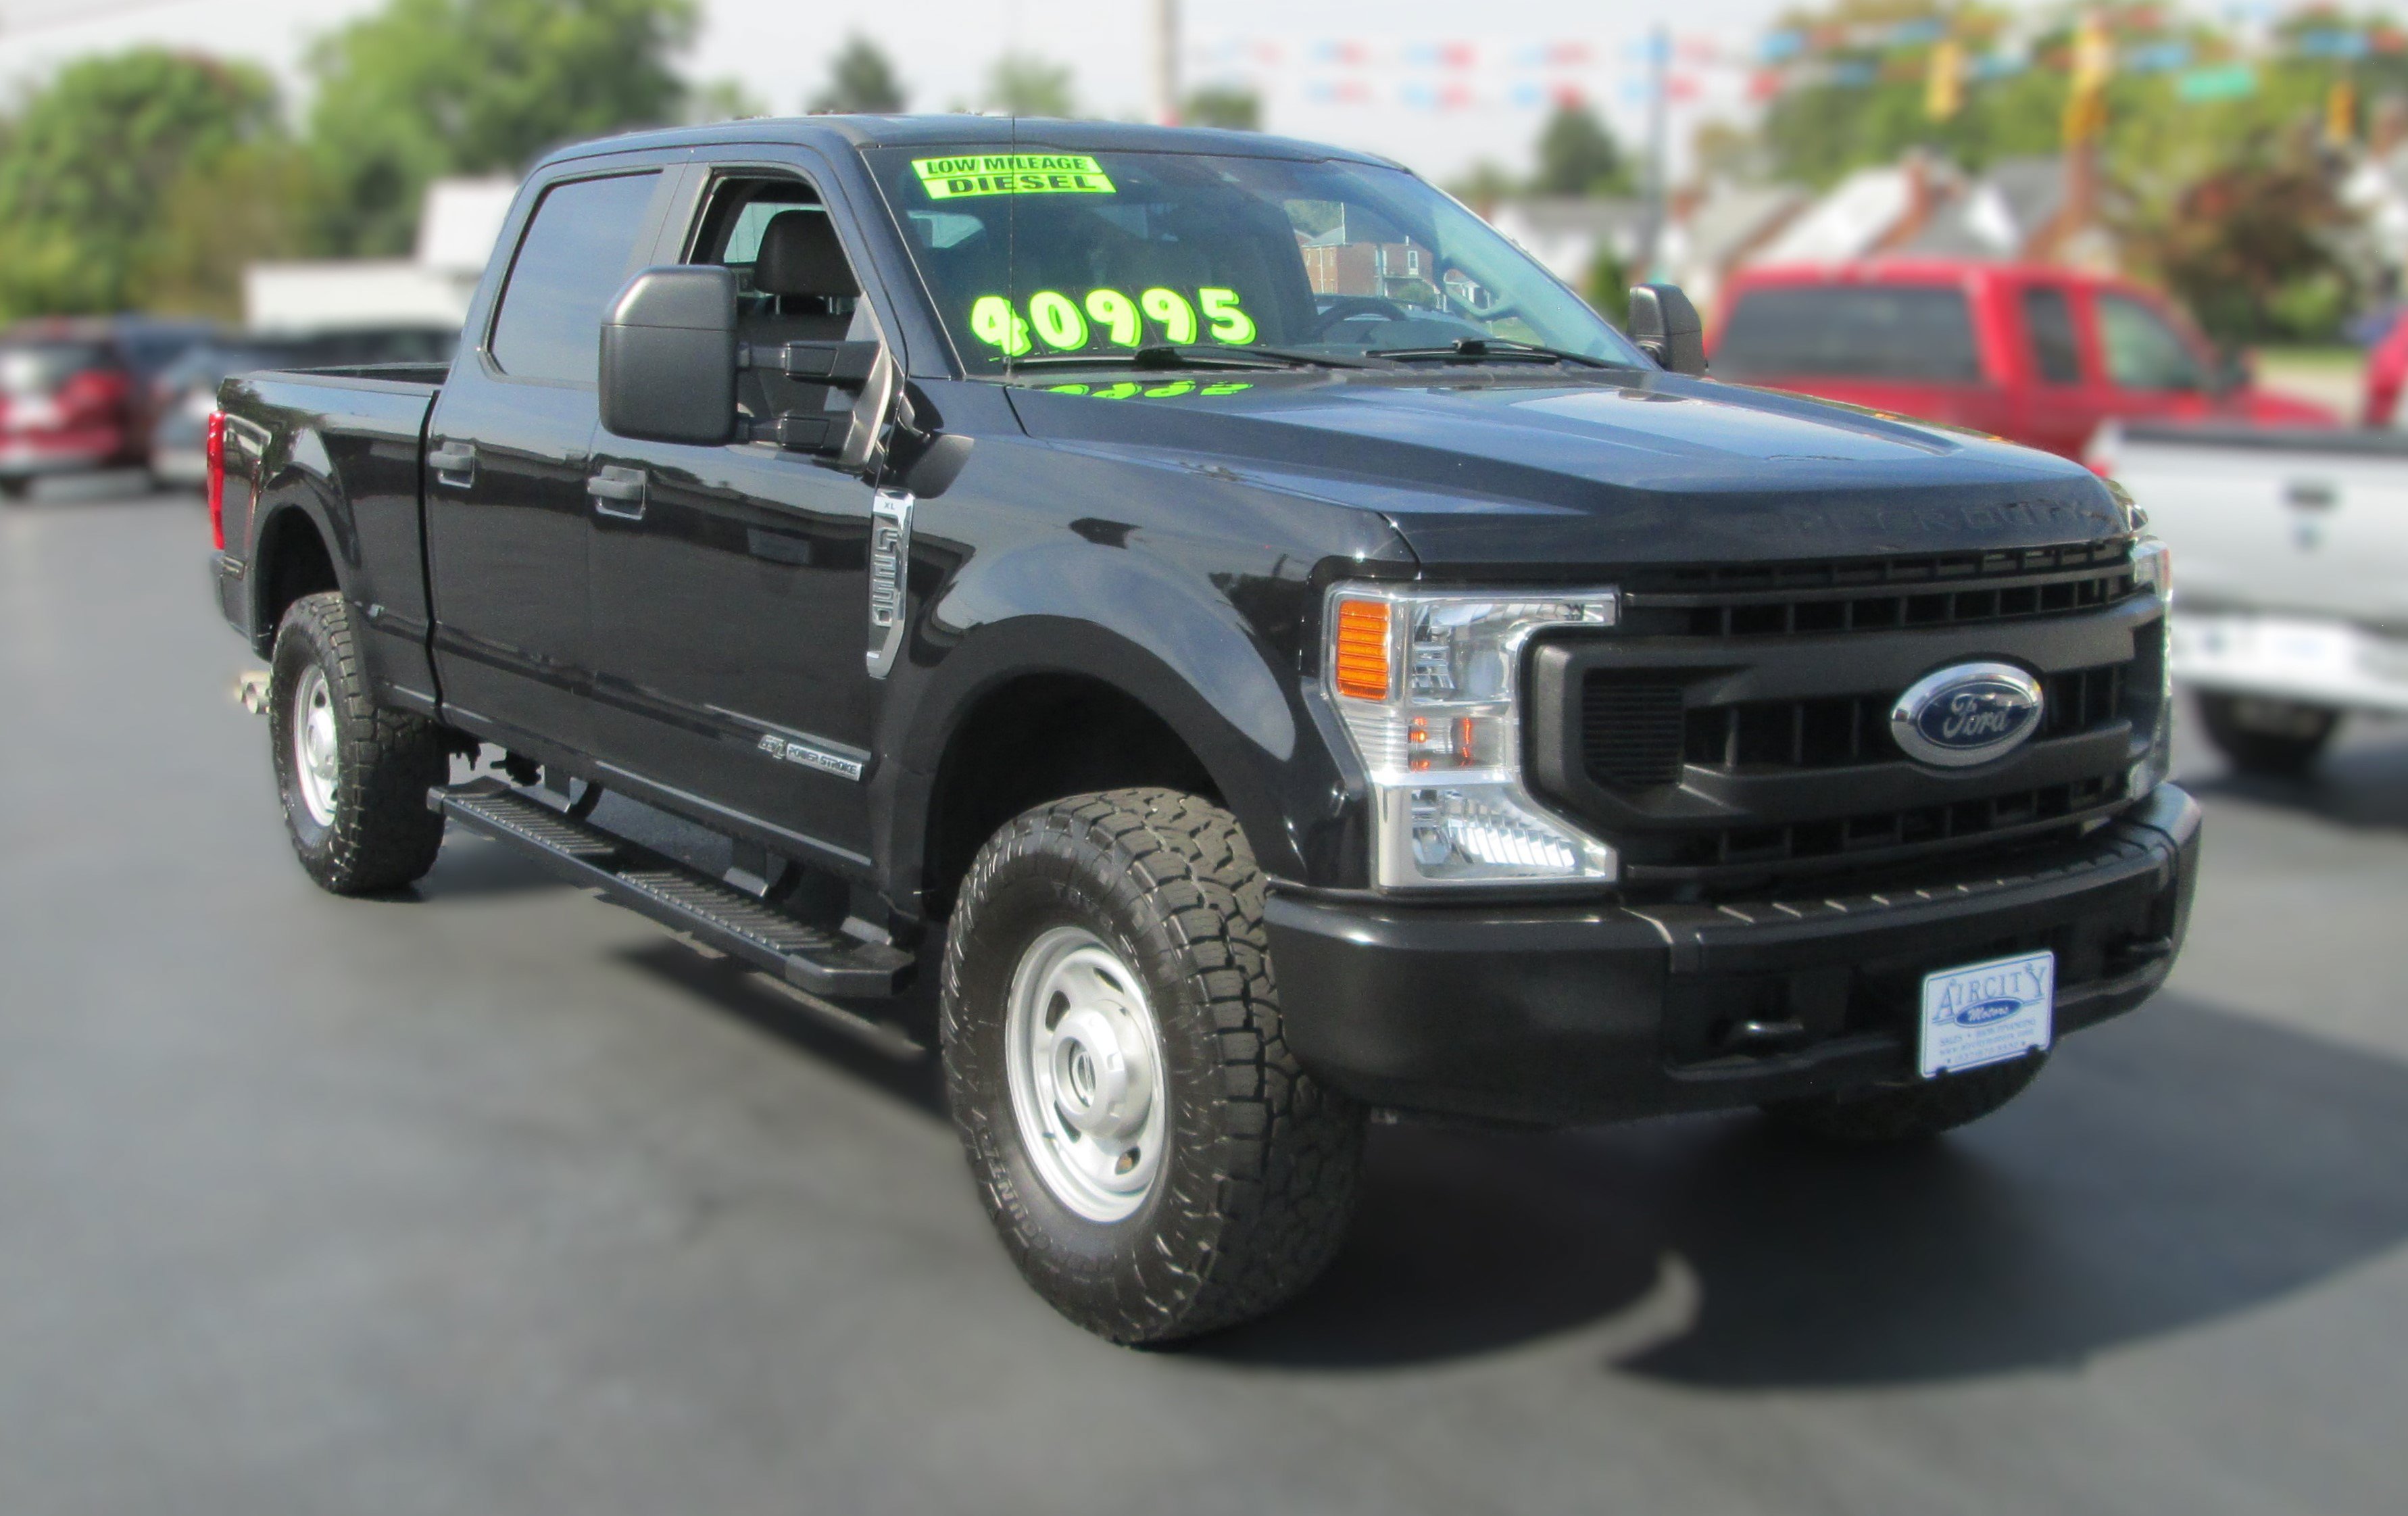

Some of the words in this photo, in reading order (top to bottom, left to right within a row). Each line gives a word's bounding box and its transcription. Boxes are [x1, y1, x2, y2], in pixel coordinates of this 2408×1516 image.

[927, 158, 975, 174] LOW
[984, 157, 1085, 170] MILEAGE
[947, 176, 1097, 193] DIESEL
[971, 287, 1256, 357] 40995
[884, 502, 895, 511] XL
[1943, 693, 2012, 739] Ford
[788, 746, 818, 763] POWER
[820, 756, 857, 774] STROKE
[1932, 961, 2046, 1021] AIRCITY
